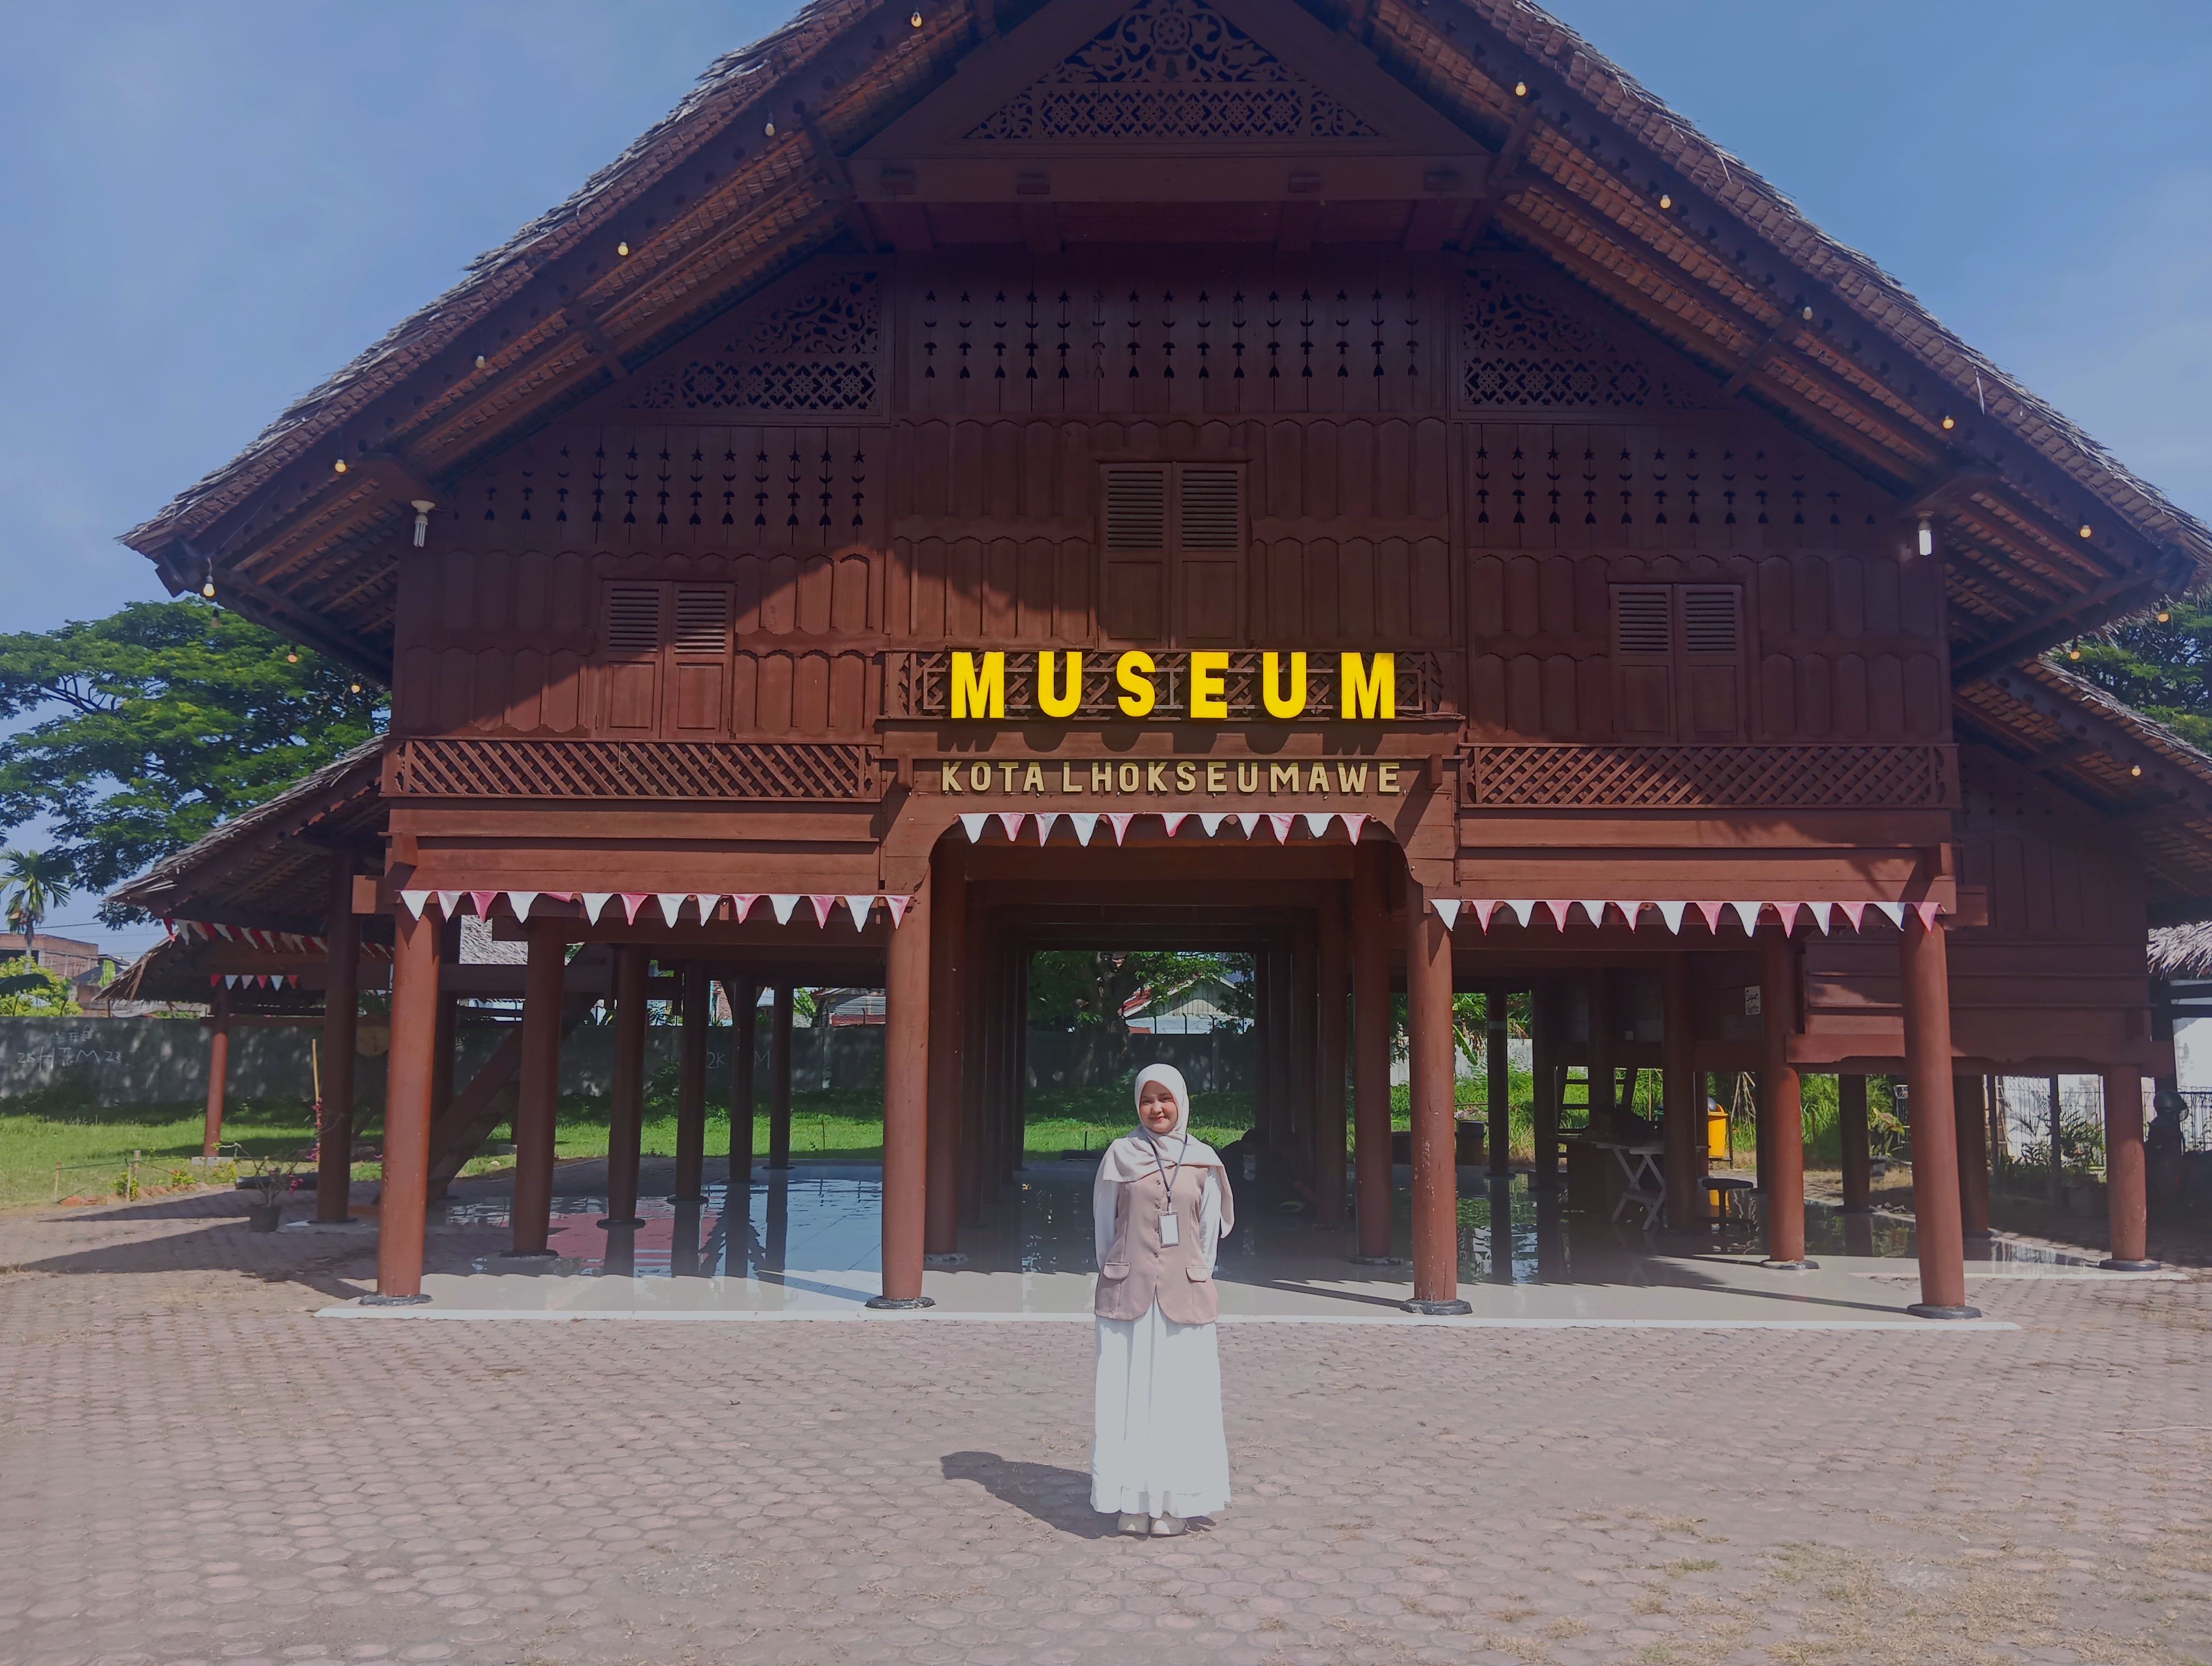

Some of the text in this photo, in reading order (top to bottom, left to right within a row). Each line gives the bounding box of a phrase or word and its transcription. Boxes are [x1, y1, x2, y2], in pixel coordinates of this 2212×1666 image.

[951, 650, 1396, 719] MUSEUM
[942, 761, 1401, 793] KOTA LHOKSEUMAWE
[105, 1051, 122, 1064] 23
